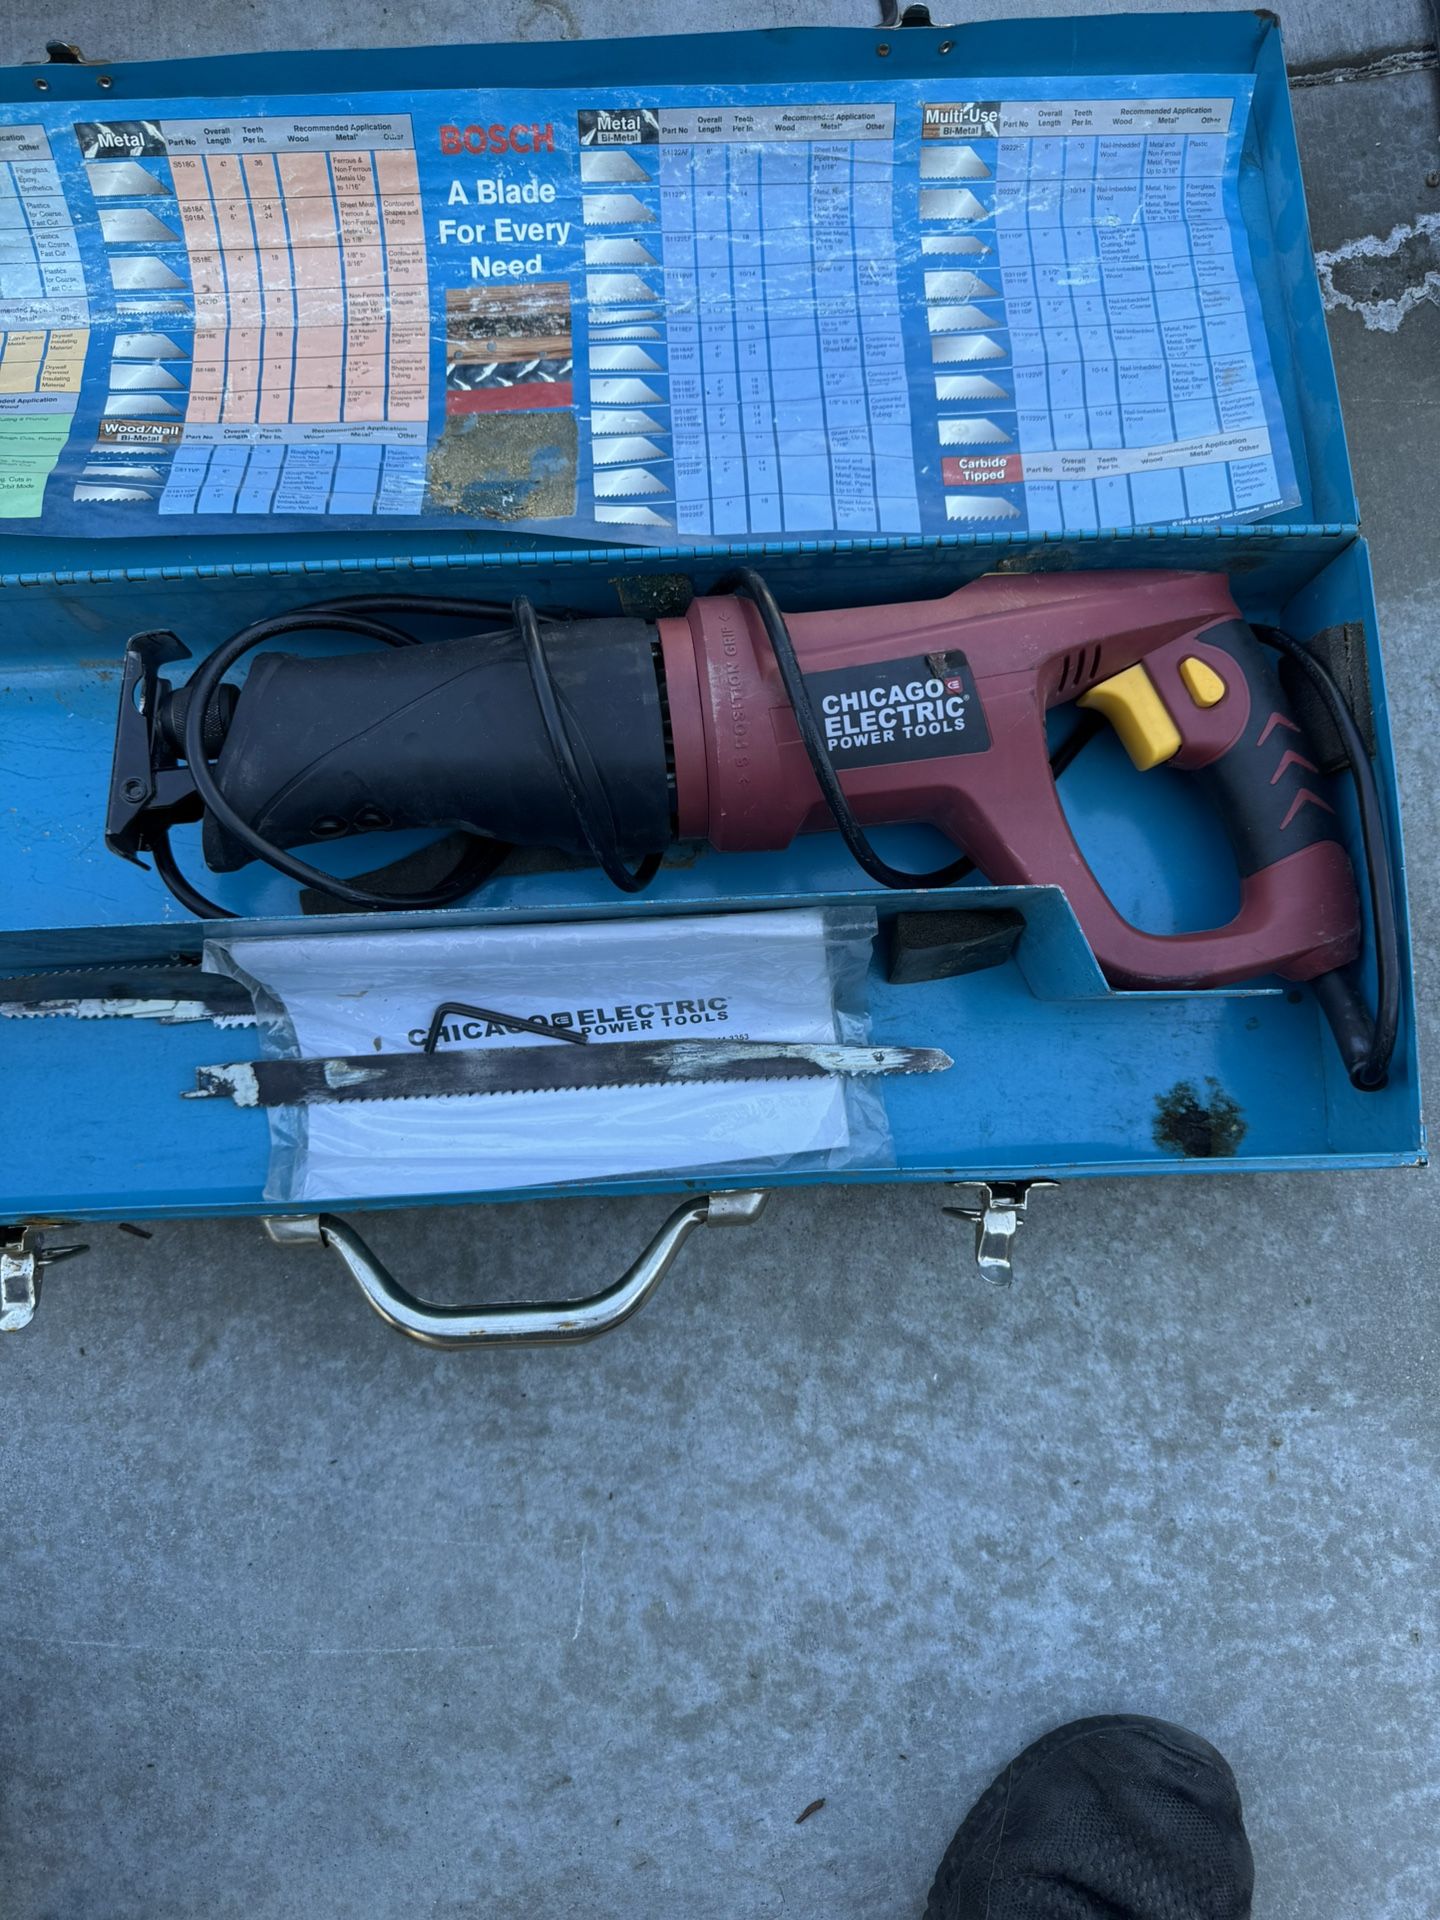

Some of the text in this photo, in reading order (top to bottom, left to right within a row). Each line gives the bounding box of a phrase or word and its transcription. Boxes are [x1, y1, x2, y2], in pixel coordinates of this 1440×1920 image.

[926, 108, 998, 124] Multi-Use
[1074, 109, 1093, 117] Teeth
[1120, 107, 1212, 116] Recommended Application
[697, 116, 723, 124] Overall
[782, 112, 876, 122] Recommended Application
[1201, 116, 1221, 124] Other
[597, 116, 641, 131] Metal
[865, 122, 885, 131] Other
[1003, 120, 1018, 128] Part
[1038, 119, 1062, 127] Length
[1084, 118, 1094, 126] In.
[203, 127, 231, 135] Overall
[242, 126, 264, 134] Teeth
[293, 123, 392, 133] Recommended Application
[661, 126, 689, 135] Part No
[698, 125, 722, 134] Length
[774, 124, 795, 132] Wood
[943, 126, 979, 136] Bi-Metal
[97, 132, 146, 149] Metal
[168, 138, 184, 146] Part
[206, 137, 232, 146] Length
[242, 136, 256, 144] Per
[438, 123, 556, 156] BOSCH
[601, 133, 638, 142] Bi-Metal
[1165, 159, 1180, 167] Pipes
[447, 178, 556, 205] A Blade
[384, 209, 407, 217] Shapes
[438, 218, 571, 246] For Every
[470, 254, 542, 279] Need
[17, 396, 58, 405] Application
[104, 423, 181, 436] Wood/Nail
[120, 434, 160, 442] Bi-Metal
[1205, 436, 1247, 449] Application
[1238, 444, 1260, 452] Other
[959, 458, 1007, 470] Carbide
[1062, 465, 1086, 473] Length
[962, 470, 1005, 482] Tipped
[822, 678, 944, 715] CHICAGO
[828, 718, 966, 751] POWER TOOLS
[577, 997, 729, 1026] ELECTRIC
[581, 1011, 729, 1036] POWER TOOLS
